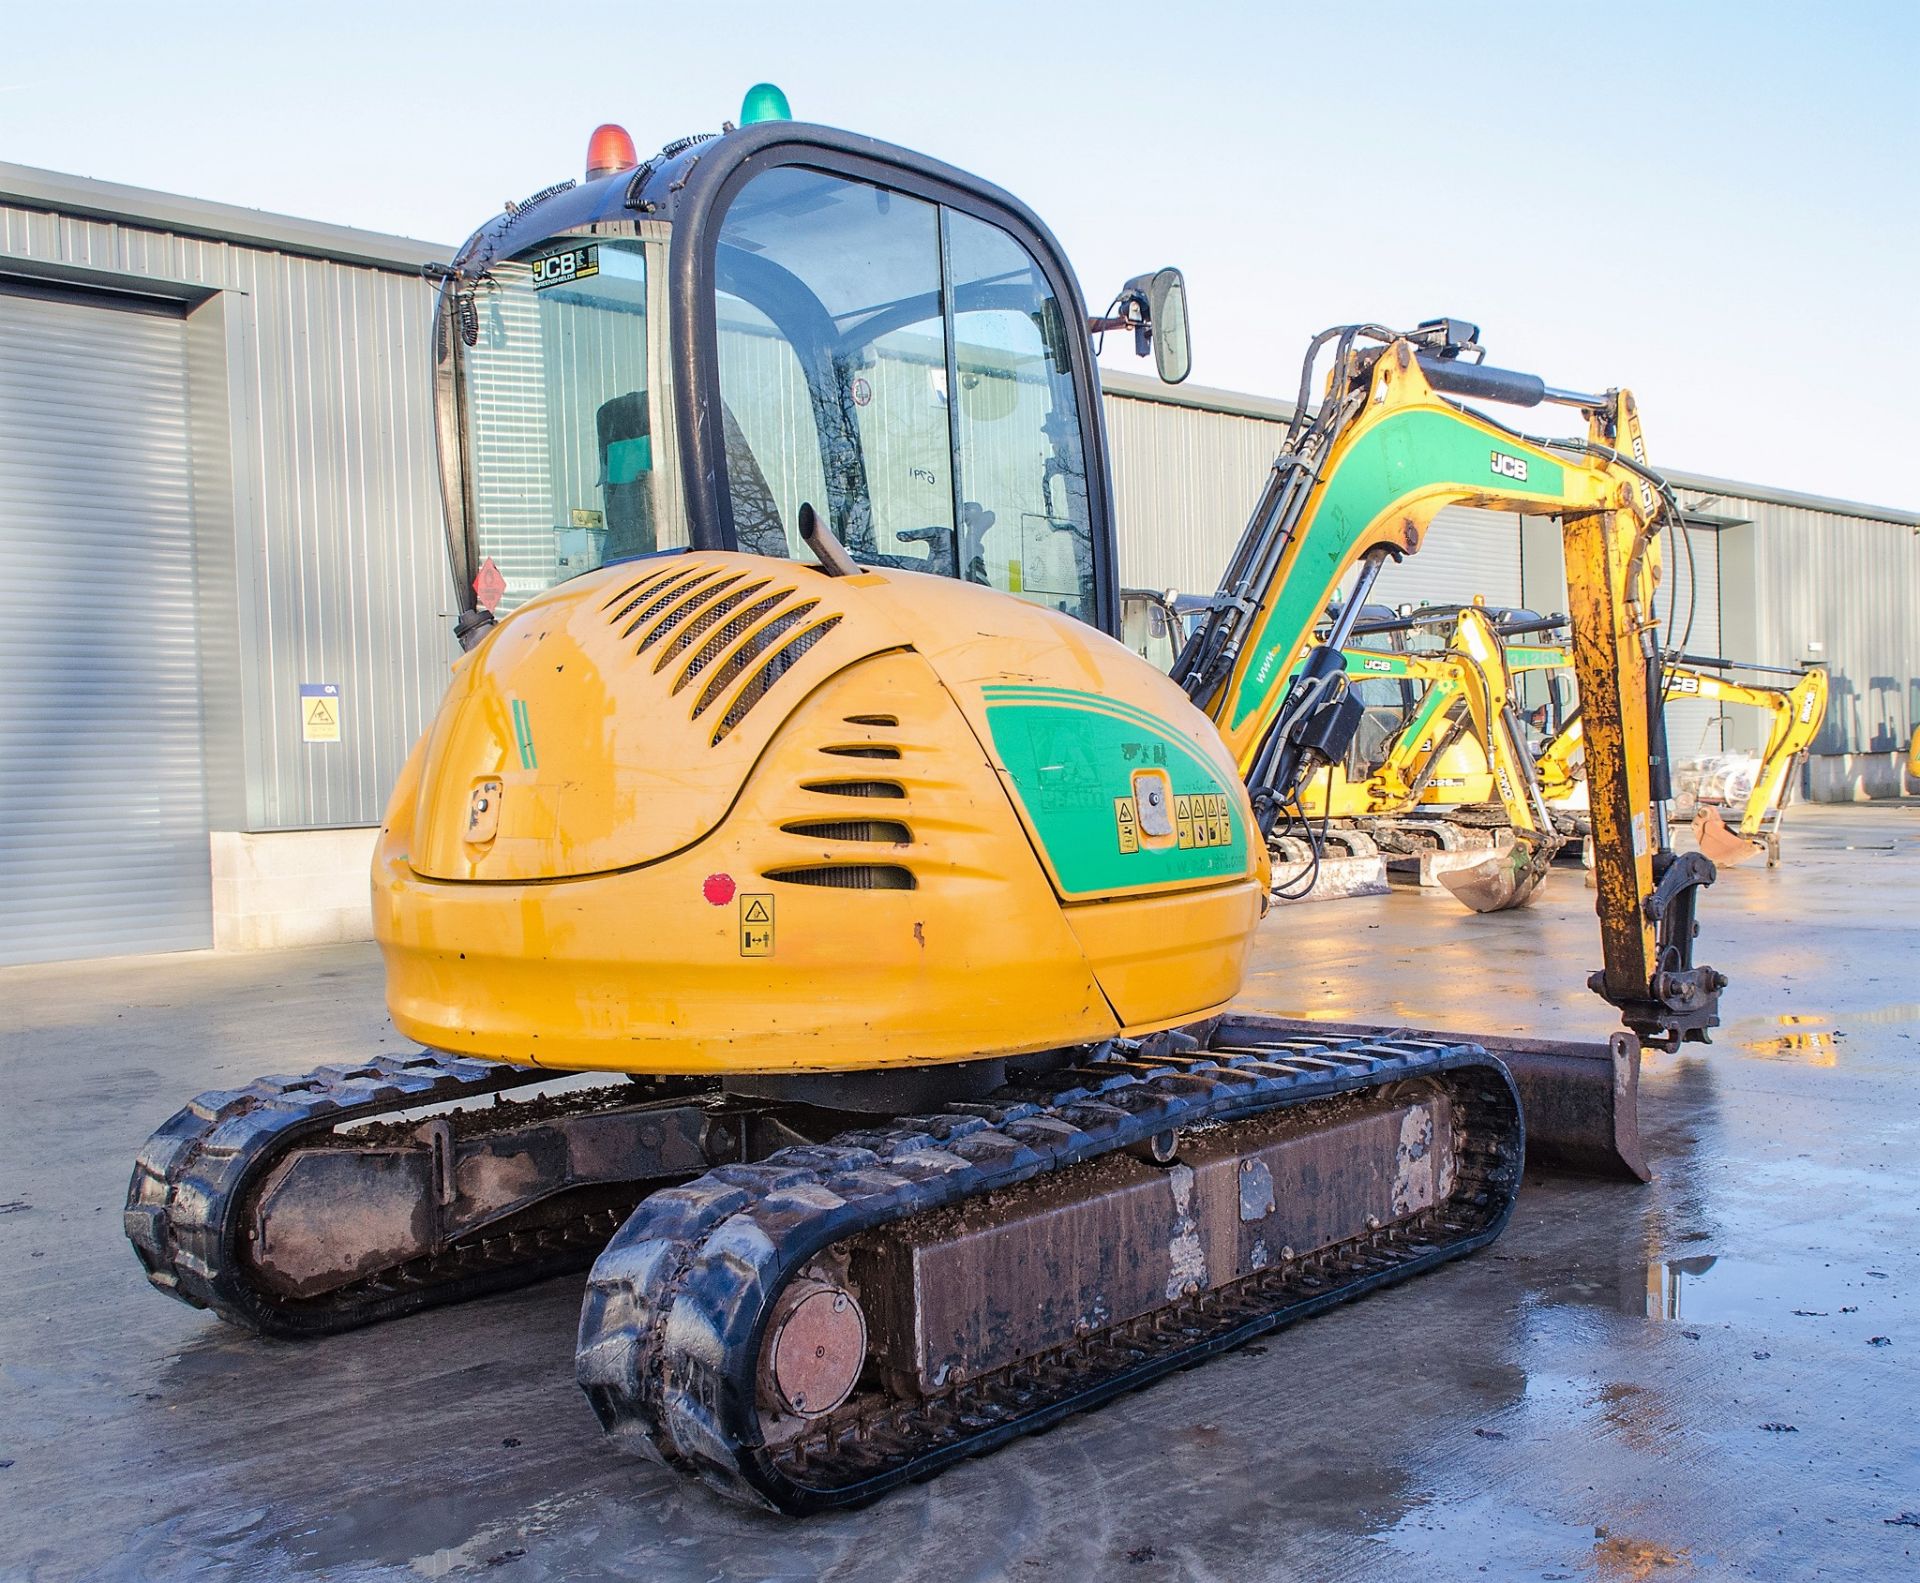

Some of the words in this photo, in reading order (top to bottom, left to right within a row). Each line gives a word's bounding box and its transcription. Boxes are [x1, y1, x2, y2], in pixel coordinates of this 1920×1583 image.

[534, 252, 576, 282] JCB
[1491, 451, 1527, 481] JCB
[1364, 659, 1391, 671] JCB
